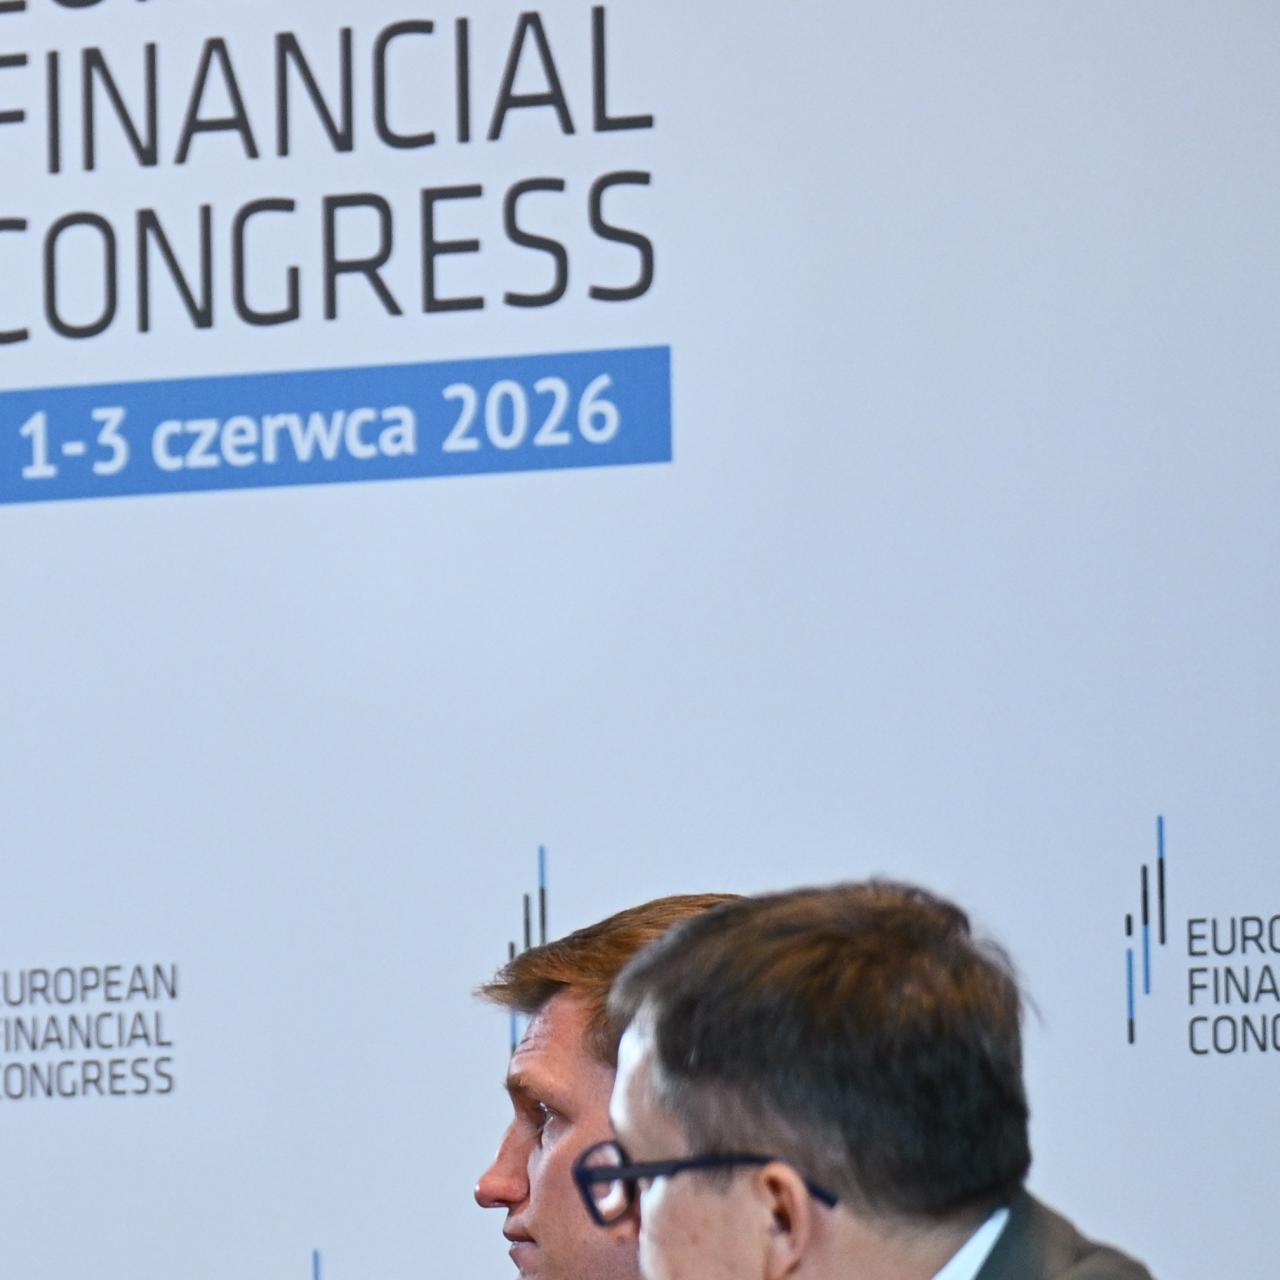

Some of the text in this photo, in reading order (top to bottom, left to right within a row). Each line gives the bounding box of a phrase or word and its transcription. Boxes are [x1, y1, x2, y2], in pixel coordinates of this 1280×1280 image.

[18, 373, 622, 480] 1-3 czerwca 2026
[1188, 965, 1280, 1005] FINA
